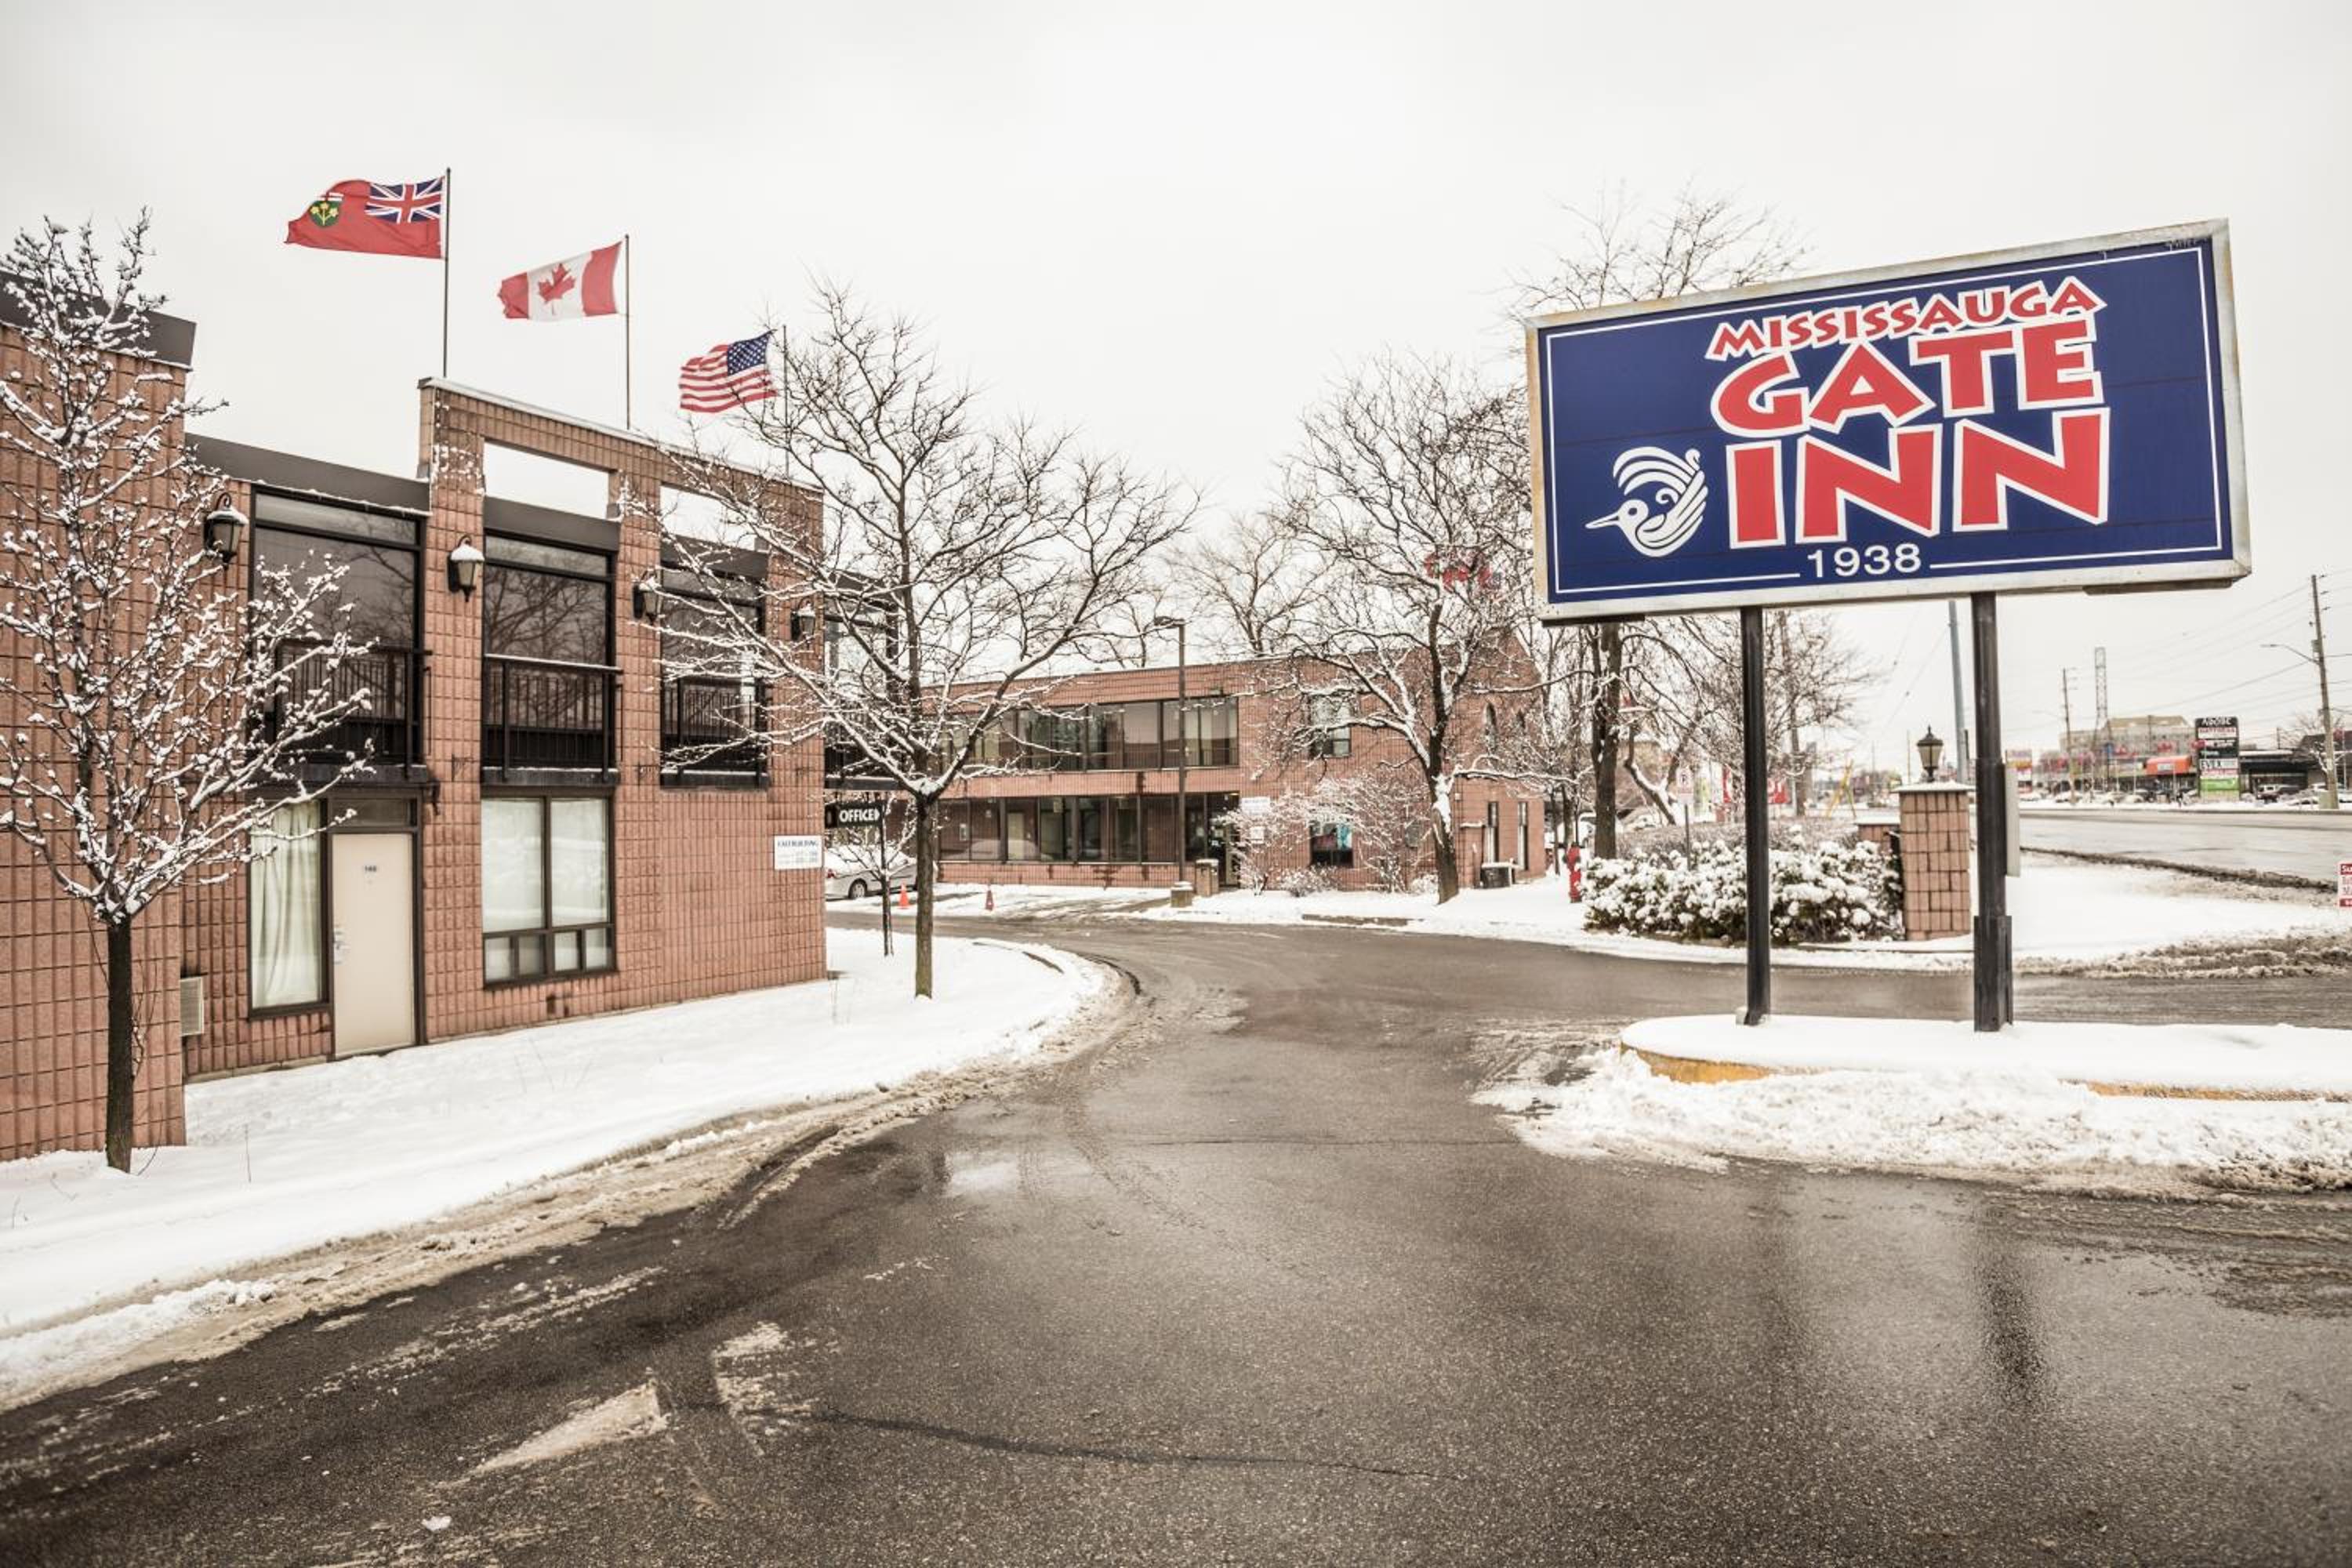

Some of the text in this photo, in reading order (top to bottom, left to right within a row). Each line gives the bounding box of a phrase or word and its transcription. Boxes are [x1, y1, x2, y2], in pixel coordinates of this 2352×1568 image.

[1706, 276, 2107, 361] MISSISSAUGA
[1711, 316, 2103, 437] GATE
[1726, 408, 2110, 548] INN
[1806, 544, 1922, 579] 1938
[840, 808, 874, 822] OFFICE
